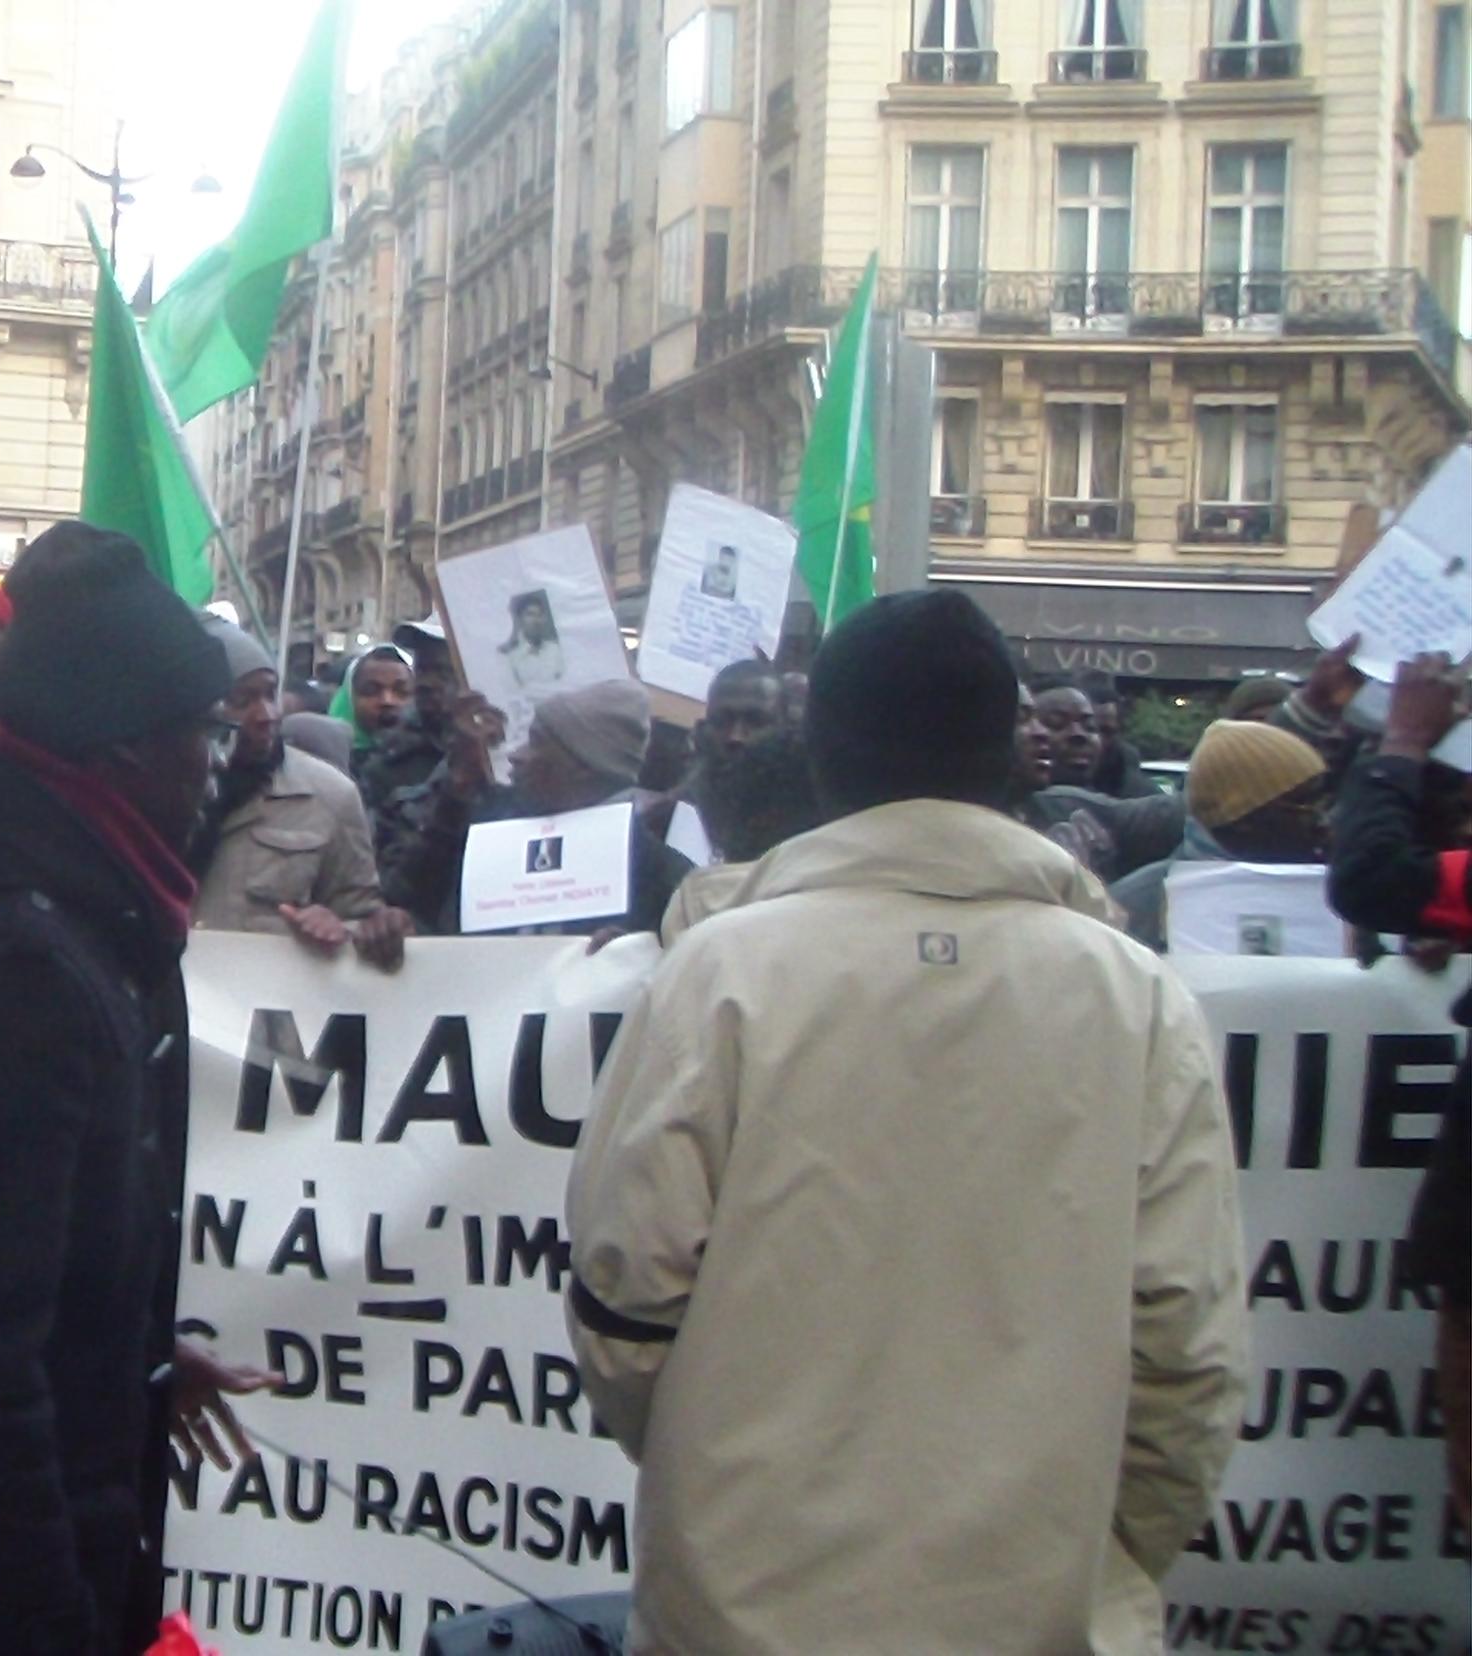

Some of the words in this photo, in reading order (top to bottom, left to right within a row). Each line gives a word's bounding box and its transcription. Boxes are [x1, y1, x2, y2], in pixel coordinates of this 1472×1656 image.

[1043, 622, 1218, 641] VINO
[1054, 648, 1157, 675] VINO
[234, 1009, 624, 1148] MAU
[190, 1194, 246, 1269] N
[265, 1329, 366, 1405] DE
[413, 1339, 612, 1438] PAR
[220, 1453, 328, 1523] AU
[354, 1463, 629, 1573] RACISM
[1328, 1614, 1442, 1656] DES
